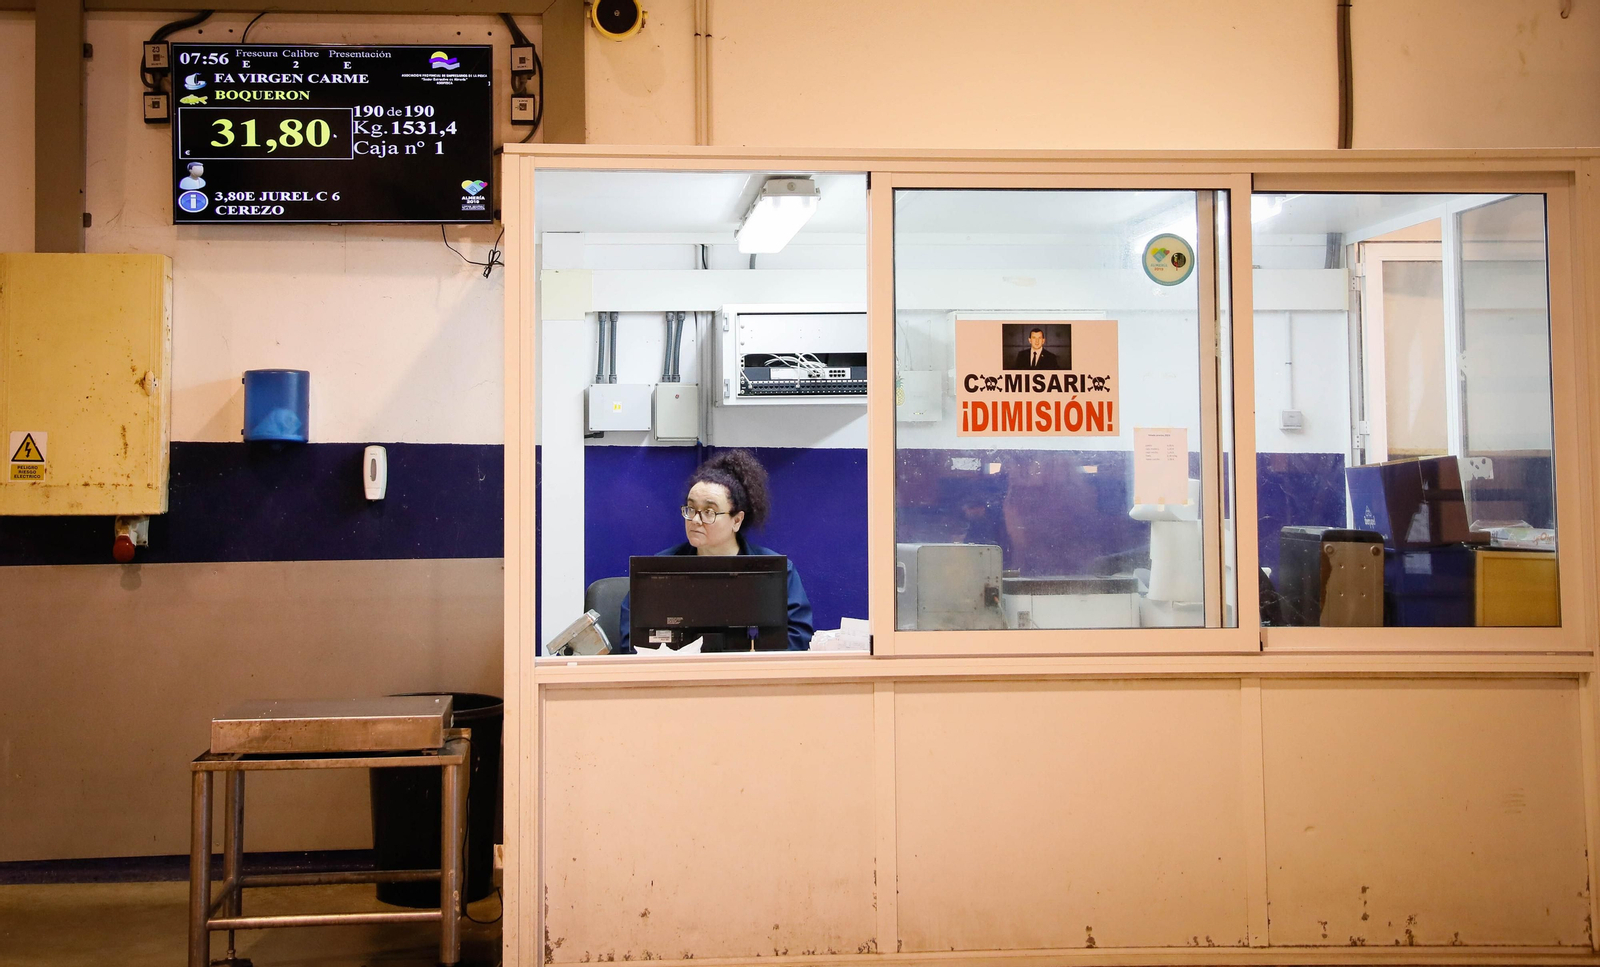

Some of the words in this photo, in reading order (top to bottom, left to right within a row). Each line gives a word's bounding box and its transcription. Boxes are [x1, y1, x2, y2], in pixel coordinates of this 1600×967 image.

[179, 51, 229, 65] 07:56
[235, 49, 278, 58] Frescura
[282, 49, 319, 58] Calibre
[328, 49, 392, 58] Presentación
[242, 60, 251, 68] E
[292, 60, 300, 69] 2
[343, 61, 352, 69] E
[214, 73, 235, 83] FA
[238, 73, 304, 84] VIRGEN
[307, 73, 369, 84] CARME
[215, 90, 310, 102] BOQUERON
[353, 105, 384, 117] 190
[386, 107, 403, 117] de
[404, 105, 435, 117] 190
[353, 120, 388, 138] Kg.
[391, 121, 458, 138] 1531,4
[210, 118, 331, 153] 31,80
[353, 140, 399, 159] Caja
[434, 141, 445, 155] 1
[214, 191, 256, 203] 3,80E
[259, 191, 314, 201] JUREL
[315, 191, 328, 201] C
[331, 191, 341, 201] 6
[215, 205, 285, 215] CEREZO
[962, 395, 1113, 432] ¡DIMISIÓN!
